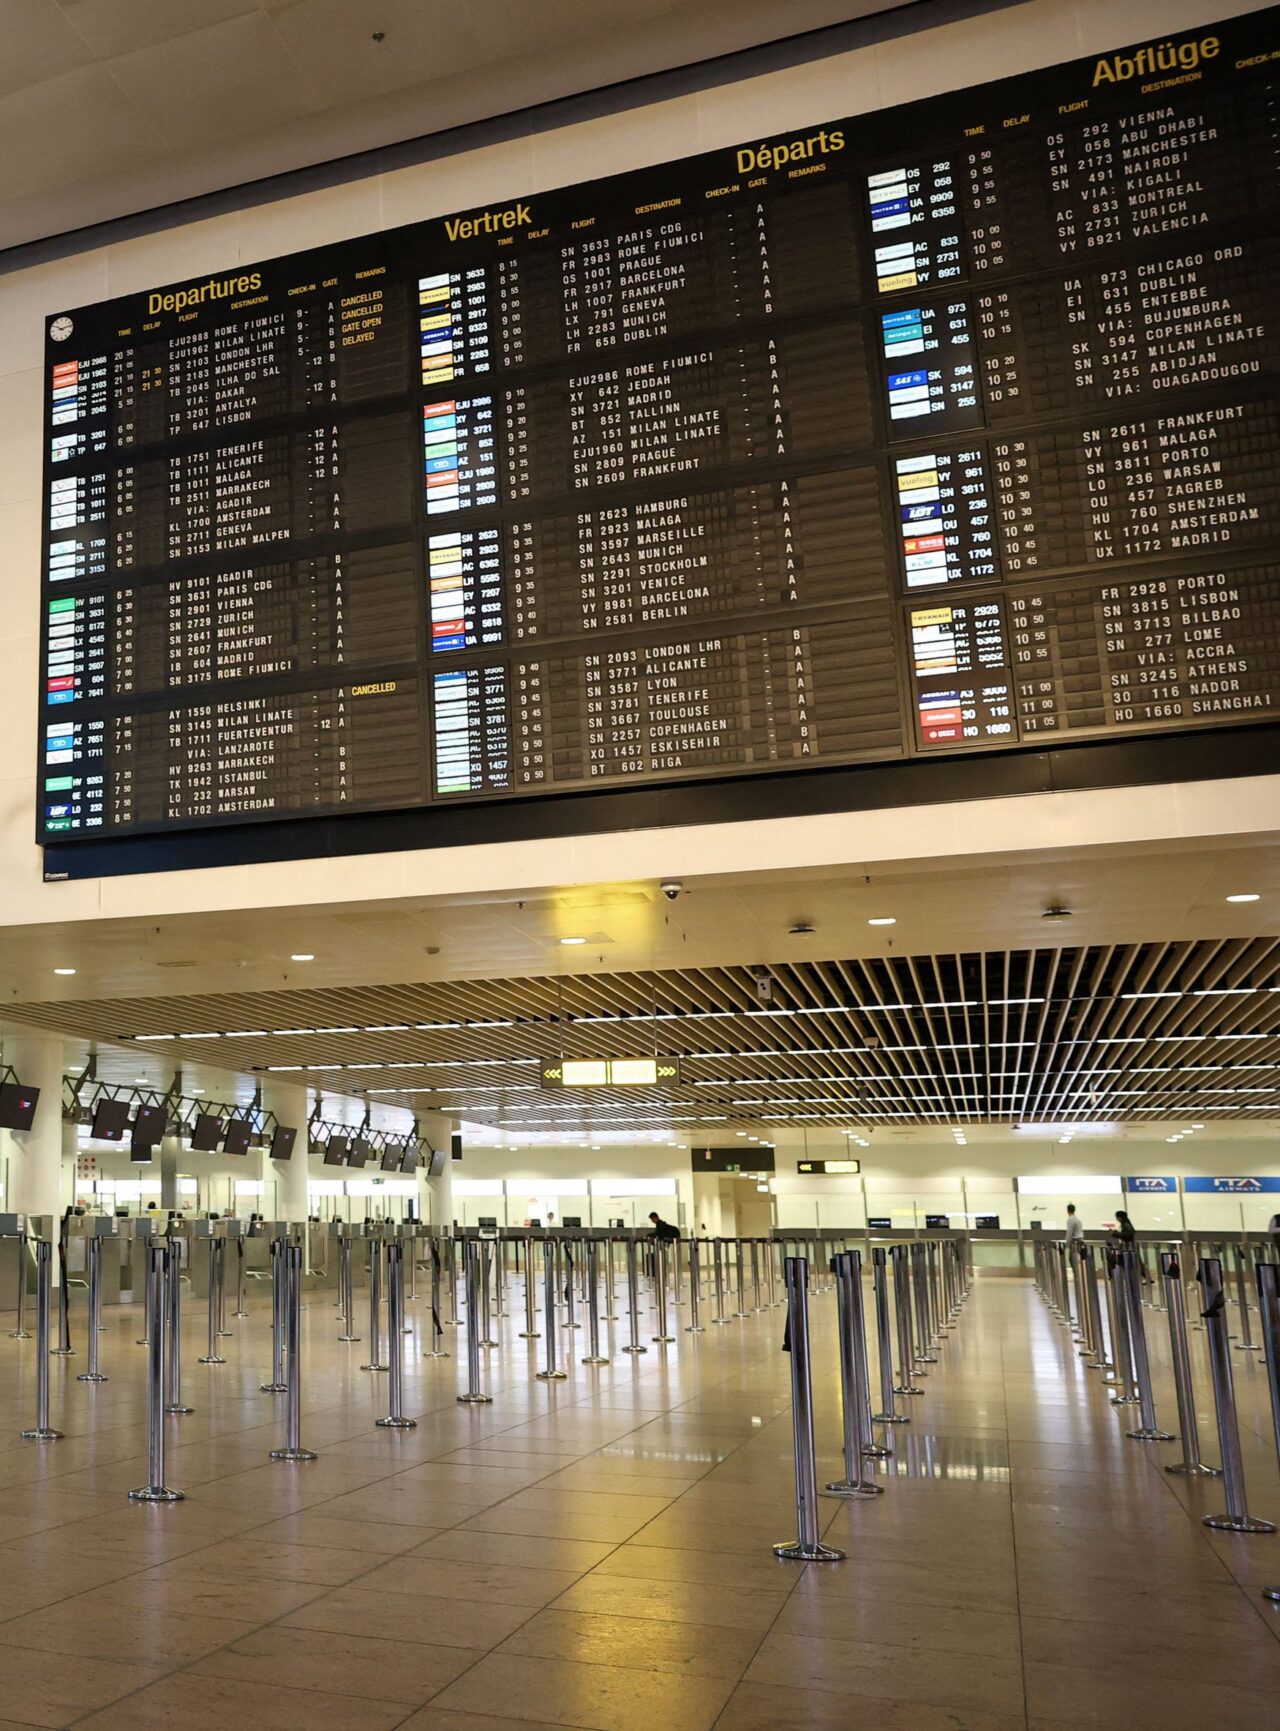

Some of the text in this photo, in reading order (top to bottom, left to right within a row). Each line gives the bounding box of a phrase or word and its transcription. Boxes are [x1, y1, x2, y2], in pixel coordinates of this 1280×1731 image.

[1092, 36, 1220, 88] Abflüge
[1141, 71, 1202, 94] DESTINATION
[1119, 107, 1174, 128] VIENNA
[1121, 116, 1203, 144] ABU DHABI
[737, 130, 845, 173] Départs
[1122, 129, 1217, 159] MANCHESTER
[1124, 152, 1187, 175] NAIROBI
[1127, 169, 1180, 190] KIGALI
[635, 184, 740, 215] DESTINATION CHECK-IN
[1128, 181, 1203, 206] MONTREAL
[1132, 201, 1187, 221] ZURICH
[445, 204, 532, 242] Vertrek
[1133, 212, 1208, 237] VALENCIA
[617, 222, 681, 244] PARIS CDG
[618, 232, 703, 258] ROME FIUMICI
[619, 255, 661, 272] PRAGUE
[1138, 246, 1242, 276] CHICAGO ORD
[620, 264, 685, 286] BARCELONA
[1140, 272, 1196, 292] DUBLIN
[148, 272, 262, 315] Departures
[231, 266, 386, 310] DESTINATION CHECK-IN GATE REMARKS
[622, 278, 685, 300] FRANKFURT
[1142, 286, 1207, 308] ENTEBBE
[215, 291, 382, 337] ROME FIUMICI CANCELLED
[622, 297, 665, 314] GENEVA
[1144, 299, 1230, 324] BUJUMBURA
[215, 304, 383, 349] MILAN LINATE CANCELLED
[623, 311, 666, 327] MUNICH
[1146, 313, 1242, 340] COPENHAGEN
[215, 317, 382, 362] LONDON LHR GATE OPEN
[624, 325, 667, 342] DUBLIN
[1148, 326, 1264, 356] MILAN LINATE
[215, 332, 374, 374] MANCHESTER DELAYED
[626, 352, 712, 377] ROME FIUMICI
[1150, 352, 1216, 373] ABIDJAN
[216, 366, 280, 387] ILHA DO SAL
[628, 375, 670, 391] JEDDAH
[1152, 361, 1259, 389] OUAGADOUGOU
[215, 386, 244, 400] DAKAR
[628, 390, 671, 406] MADRID
[216, 397, 256, 413] ANTALYA
[629, 402, 680, 420] TALLINN
[216, 411, 251, 426] LISBON
[630, 410, 719, 434] MILAN LINATE
[1158, 406, 1243, 430] FRANKFURT
[631, 425, 720, 449] MILAN LINATE
[1159, 428, 1217, 446] MALAGA
[216, 440, 263, 457] TENERIFE
[632, 448, 676, 463] PRAGUE
[1162, 446, 1209, 463] PORTO
[216, 454, 263, 471] ALICANTE
[633, 458, 699, 478] FRANKFURT
[1163, 462, 1220, 479] WARSAW
[216, 470, 251, 484] MALAGA
[901, 476, 934, 486] vueling
[216, 479, 270, 497] MARRAKECH
[1166, 479, 1223, 497] ZAGREB
[216, 496, 252, 510] AGADIR
[636, 498, 687, 515] HAMBURG
[1168, 493, 1246, 513] SHENZHEN
[216, 506, 271, 523] AMSTERDAM
[636, 514, 681, 529] MALAGA
[1171, 508, 1258, 530] AMSTERDAM
[216, 523, 252, 537] GENEVA
[637, 526, 704, 545] MARSEILLE
[1171, 530, 1230, 547] MADRID
[216, 530, 290, 550] MILAN MALPEN
[638, 544, 683, 560] MUNICH
[640, 556, 707, 575] STOCKHOLM
[217, 569, 253, 583] AGADIR
[640, 575, 684, 590] VENICE
[1178, 574, 1225, 590] PORTO
[217, 580, 272, 597] PARIS CDG
[642, 587, 709, 605] BARCELONA
[217, 597, 253, 610] VIENNA
[1180, 590, 1238, 607] LISBON
[218, 611, 254, 624] ZURICH
[642, 606, 687, 620] BERLIN
[1182, 608, 1240, 625] BILBAO
[217, 624, 254, 637] MUNICH
[1184, 627, 1222, 642] LOME
[218, 635, 272, 651] FRANKFURT
[645, 640, 721, 659] LONDON LHR
[1187, 644, 1235, 659] ACCRA
[217, 652, 254, 665] MADRID
[646, 658, 706, 674] ALICANTE
[218, 661, 291, 679] ROME FIUMICI
[1189, 660, 1247, 677] ATHENS
[647, 677, 677, 690] LYON
[1190, 680, 1239, 694] NADOR
[217, 682, 395, 713] HELSINKI CANCELLED
[648, 689, 708, 705] TENERIFE
[1193, 694, 1270, 712] SHANGHAI
[218, 709, 292, 727] MILAN LINATE
[649, 705, 709, 721] TOULOUSE
[218, 724, 293, 741] FUERTEVENTUR
[650, 719, 726, 737] COPENHAGEN
[218, 740, 274, 755] LANZAROTE
[651, 736, 720, 753] ESKISEHIR
[218, 755, 274, 769] MARRAKECH
[652, 756, 682, 768] RIGA
[219, 770, 267, 784] ISTANBUL
[218, 786, 255, 798] WARSAW
[218, 798, 275, 812] AMSTERDAM
